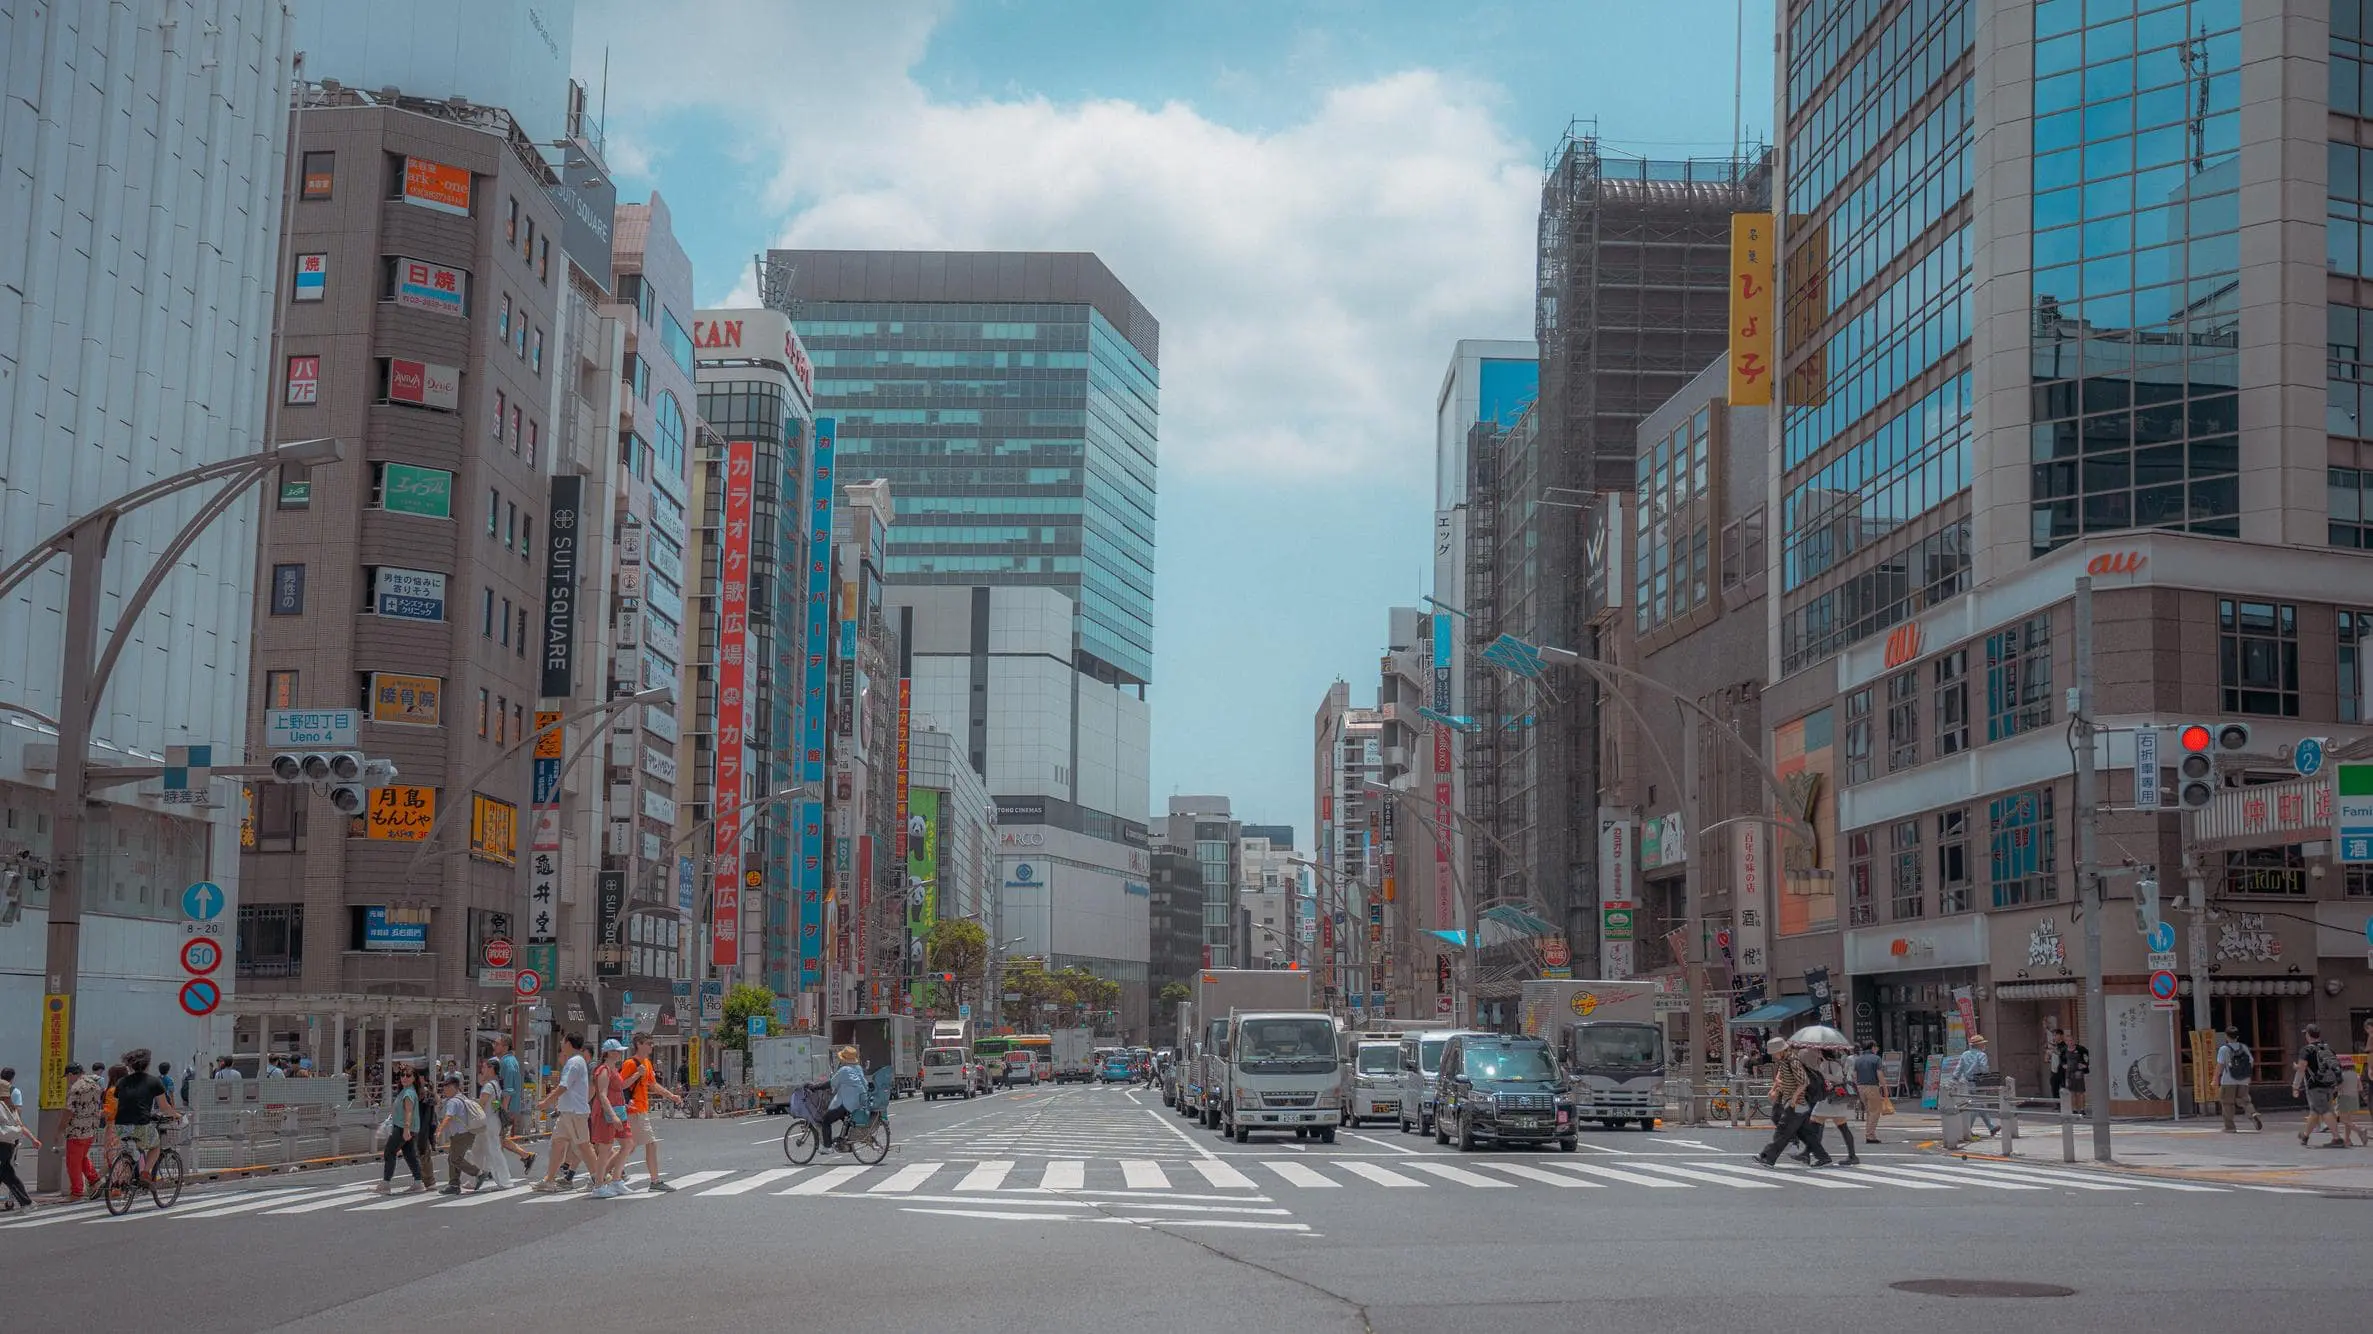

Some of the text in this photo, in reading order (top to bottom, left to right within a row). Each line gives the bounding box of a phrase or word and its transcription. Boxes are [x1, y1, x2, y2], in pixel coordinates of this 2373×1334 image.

[577, 197, 608, 244] SQUARE
[409, 264, 456, 292] 日焼
[1737, 273, 1766, 384] ひよ子
[292, 383, 315, 402] 7F
[1437, 517, 1451, 556] エッグ
[721, 455, 751, 665] カラオケ歌広場
[2087, 551, 2149, 576] au
[384, 573, 441, 591] 男性の悩みに
[548, 537, 571, 671] SUIT SQUARE
[1885, 622, 1923, 667] au
[275, 713, 349, 730] 上野四丁目
[290, 731, 333, 742] Ueno 4
[2304, 753, 2313, 771] 2
[164, 789, 209, 804] 時差式
[378, 788, 426, 808] 月島
[372, 810, 431, 827] もんじゃ
[1000, 832, 1044, 847] PARCO
[2350, 839, 2368, 858] 酒
[190, 947, 213, 964] 50
[753, 1020, 763, 1033] P
